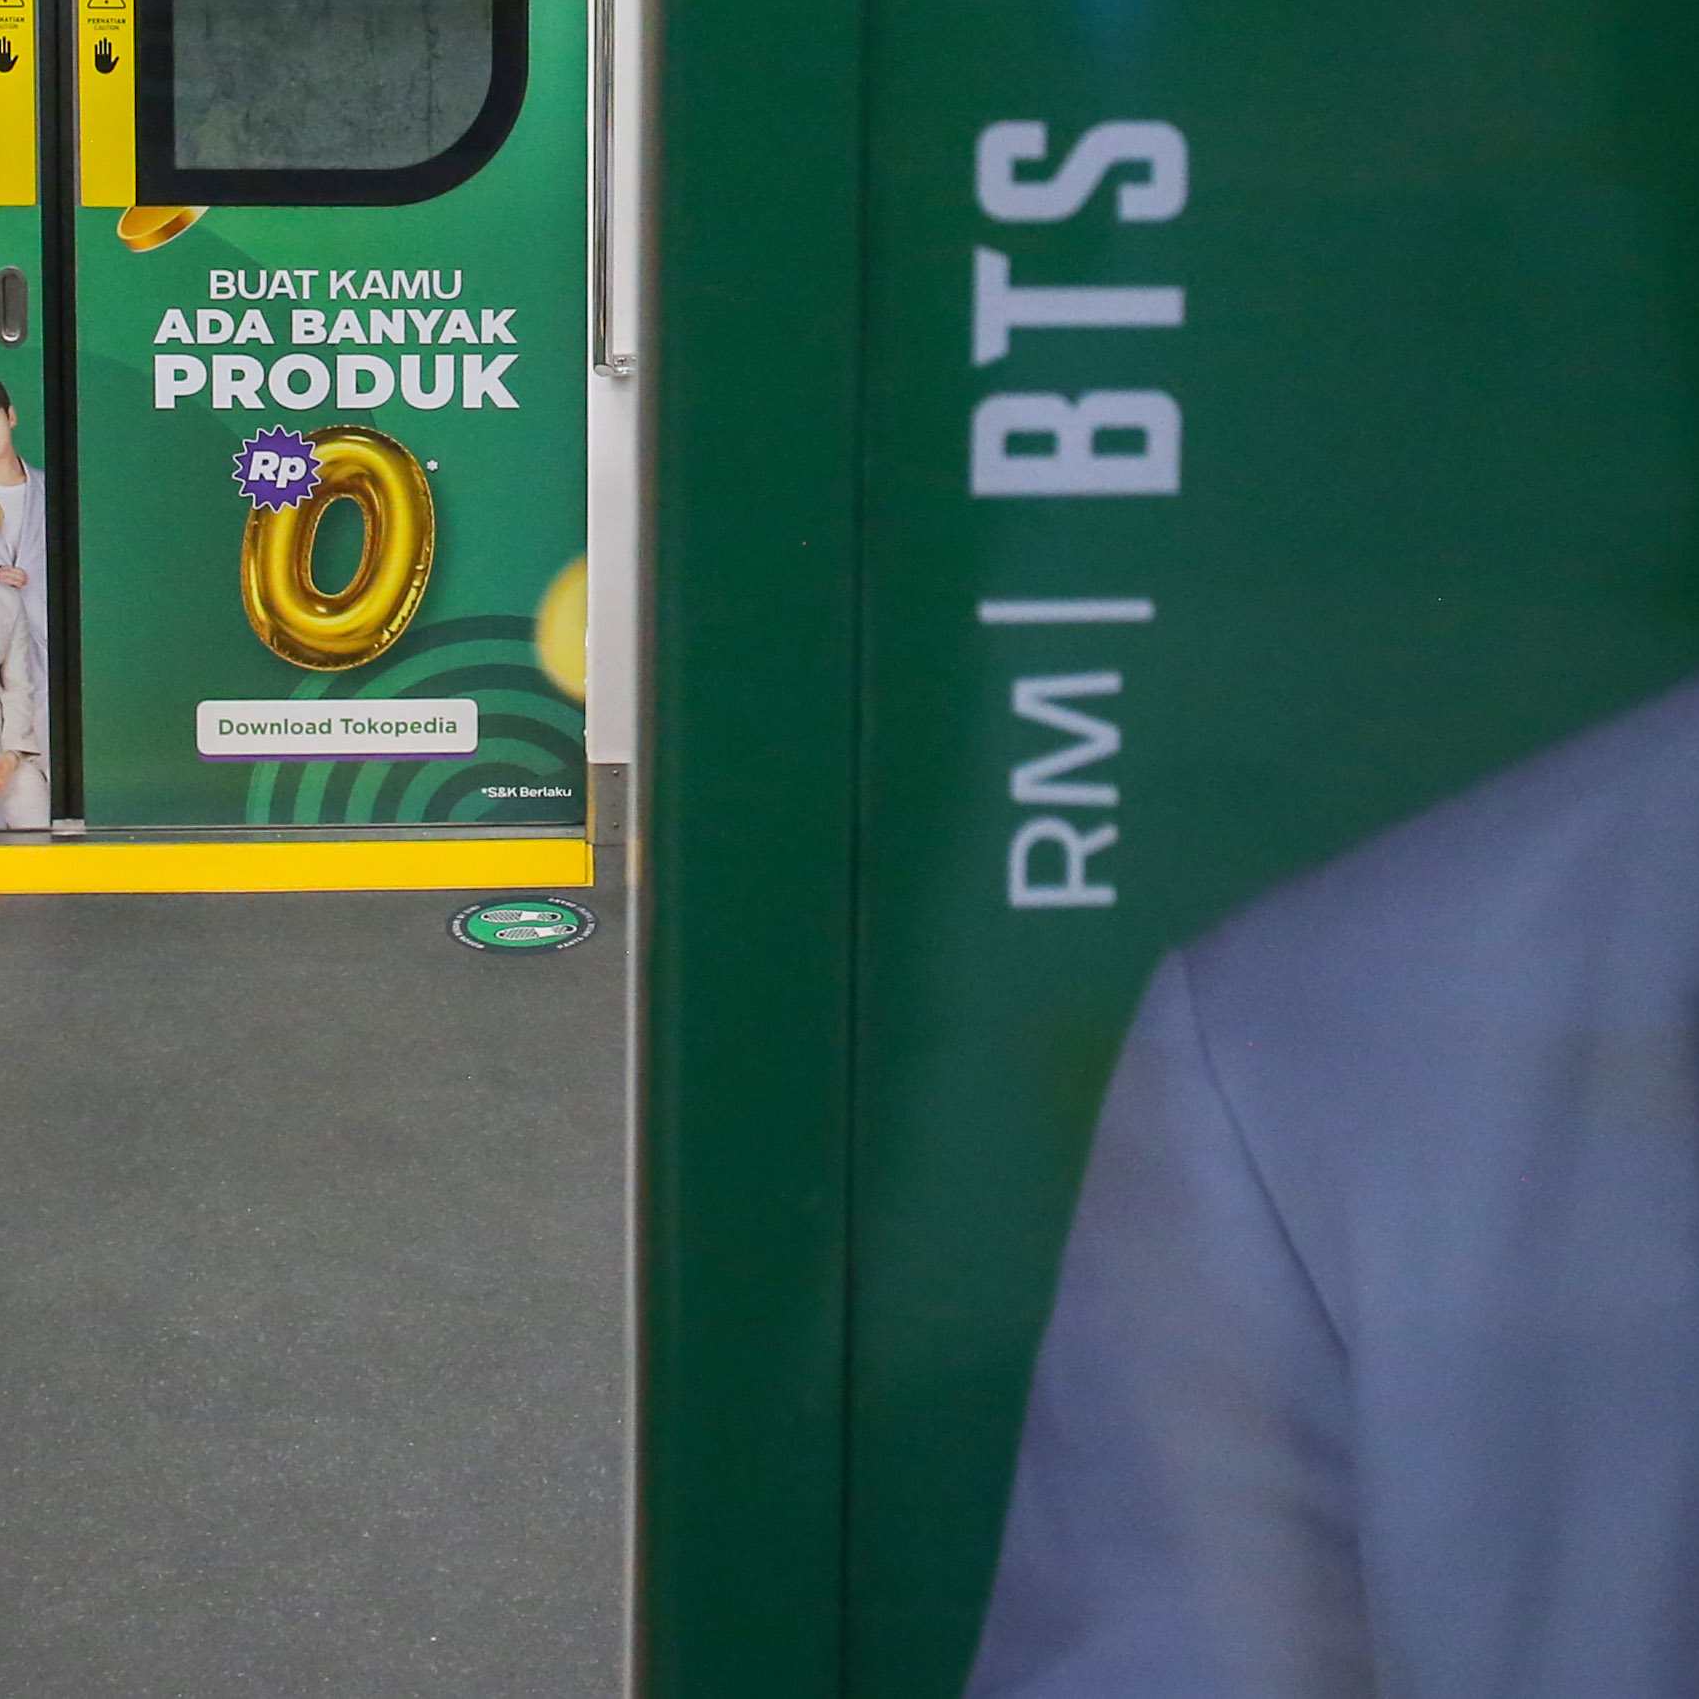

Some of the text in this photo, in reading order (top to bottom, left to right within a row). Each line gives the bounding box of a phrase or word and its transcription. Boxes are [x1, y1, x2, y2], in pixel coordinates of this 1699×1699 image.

[209, 269, 463, 301] BUAT KAMU
[971, 119, 1190, 497] BTS
[154, 309, 518, 344] ADA BANYAK
[154, 353, 520, 410] PRODUK
[248, 450, 307, 488] Rp
[218, 717, 458, 738] Download Tokopedia
[520, 786, 572, 798] Berlaku
[1008, 671, 1122, 908] RM
